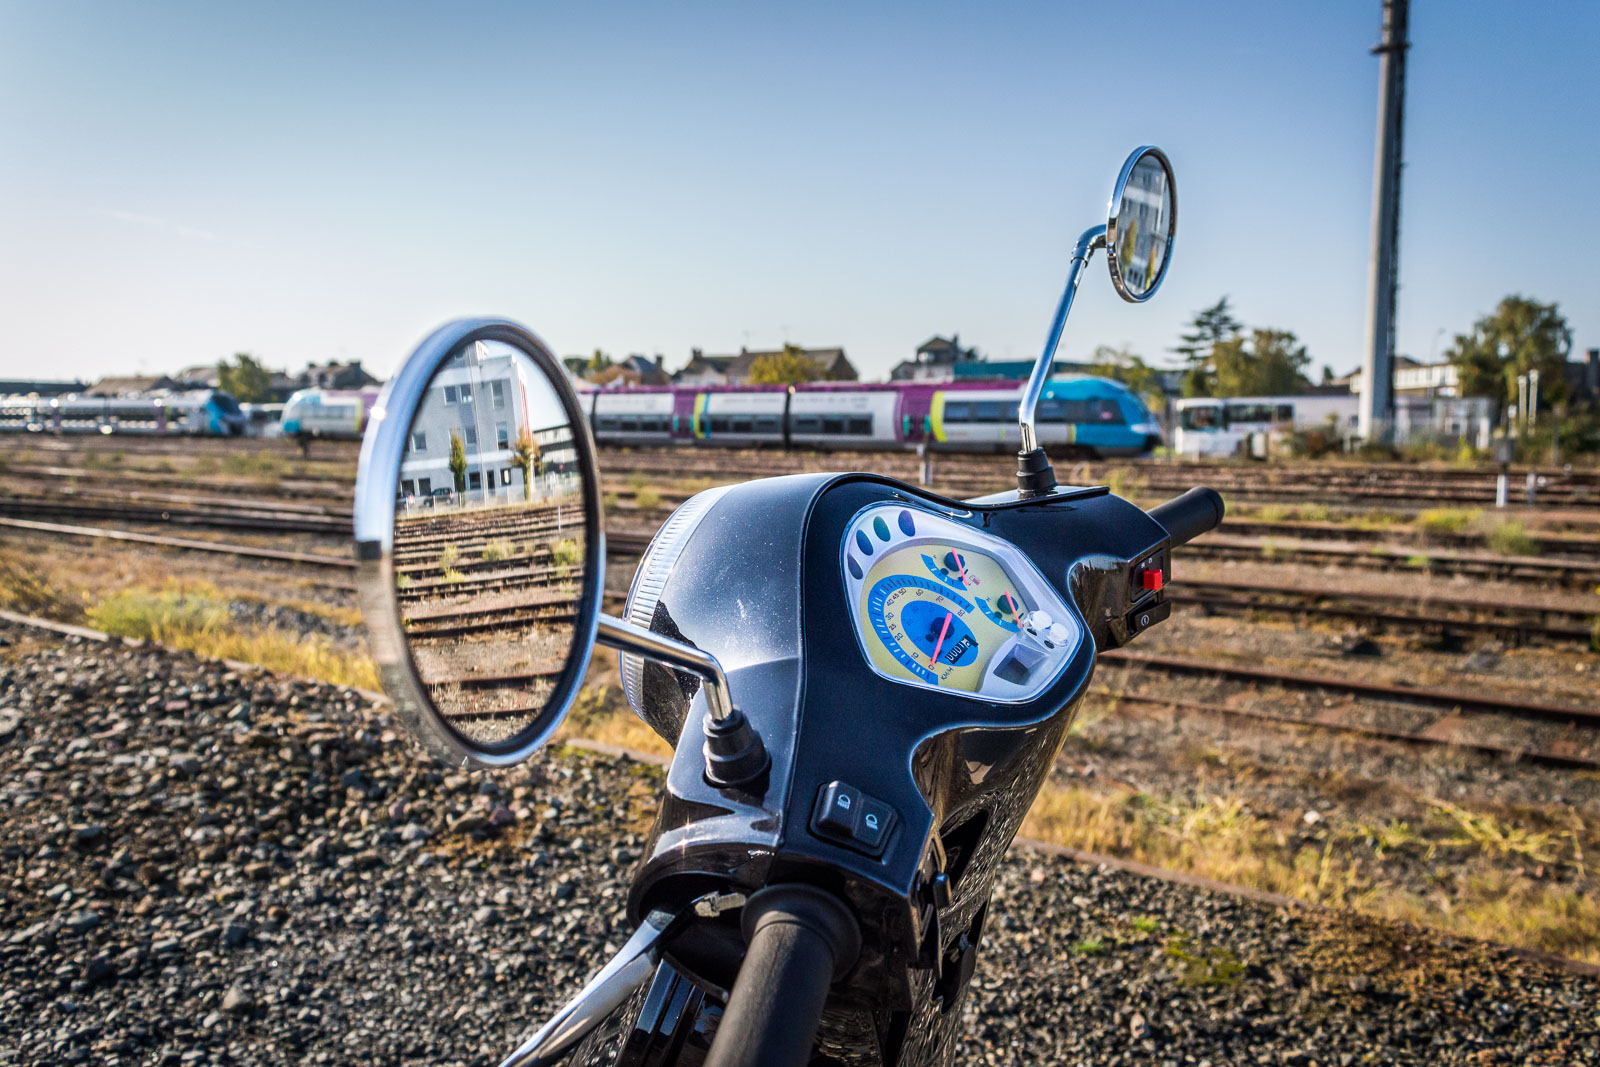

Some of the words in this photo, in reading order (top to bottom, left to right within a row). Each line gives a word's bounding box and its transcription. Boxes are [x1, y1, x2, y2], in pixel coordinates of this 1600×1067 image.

[898, 587, 907, 596] 50
[915, 588, 924, 597] 60
[886, 598, 895, 606] 40
[935, 595, 944, 603] 70
[885, 612, 894, 620] 30
[888, 623, 897, 631] 25
[894, 632, 904, 641] 20
[910, 651, 919, 659] 10
